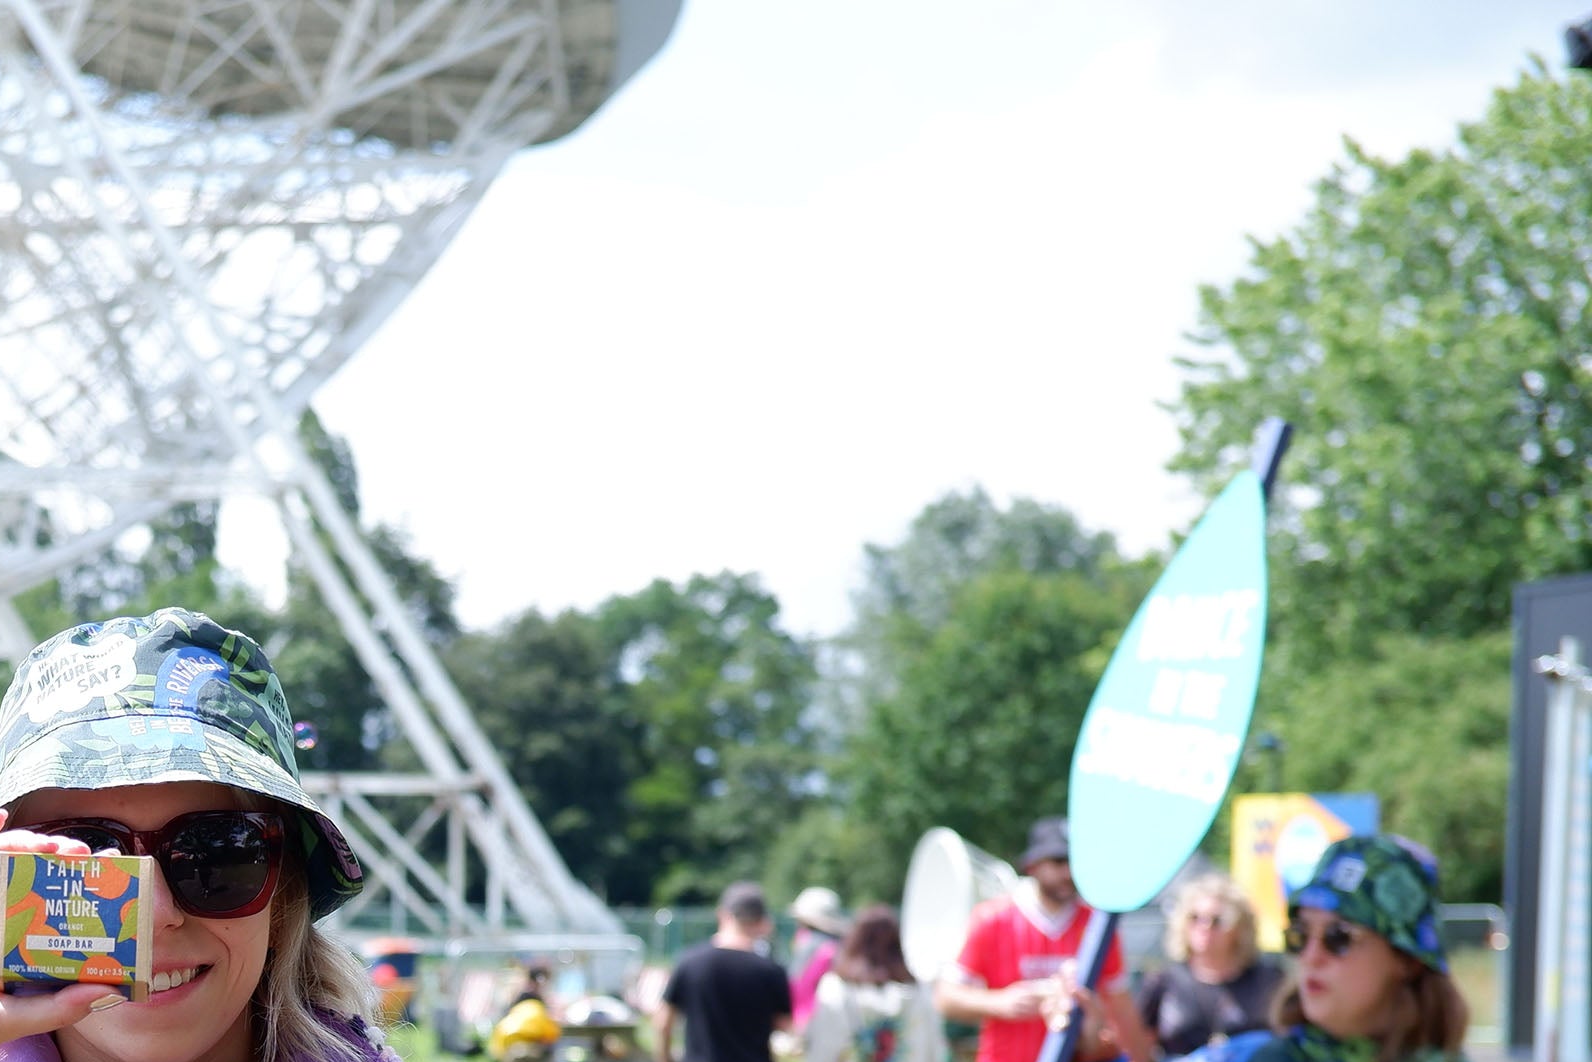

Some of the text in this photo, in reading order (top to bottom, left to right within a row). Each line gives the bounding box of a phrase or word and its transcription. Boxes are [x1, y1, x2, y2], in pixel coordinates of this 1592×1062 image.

[77, 664, 121, 694] SAY?
[46, 859, 101, 879] FAITH
[45, 899, 100, 918] NATURE
[58, 922, 84, 932] ORANGE
[47, 938, 93, 950] SOAP BAR
